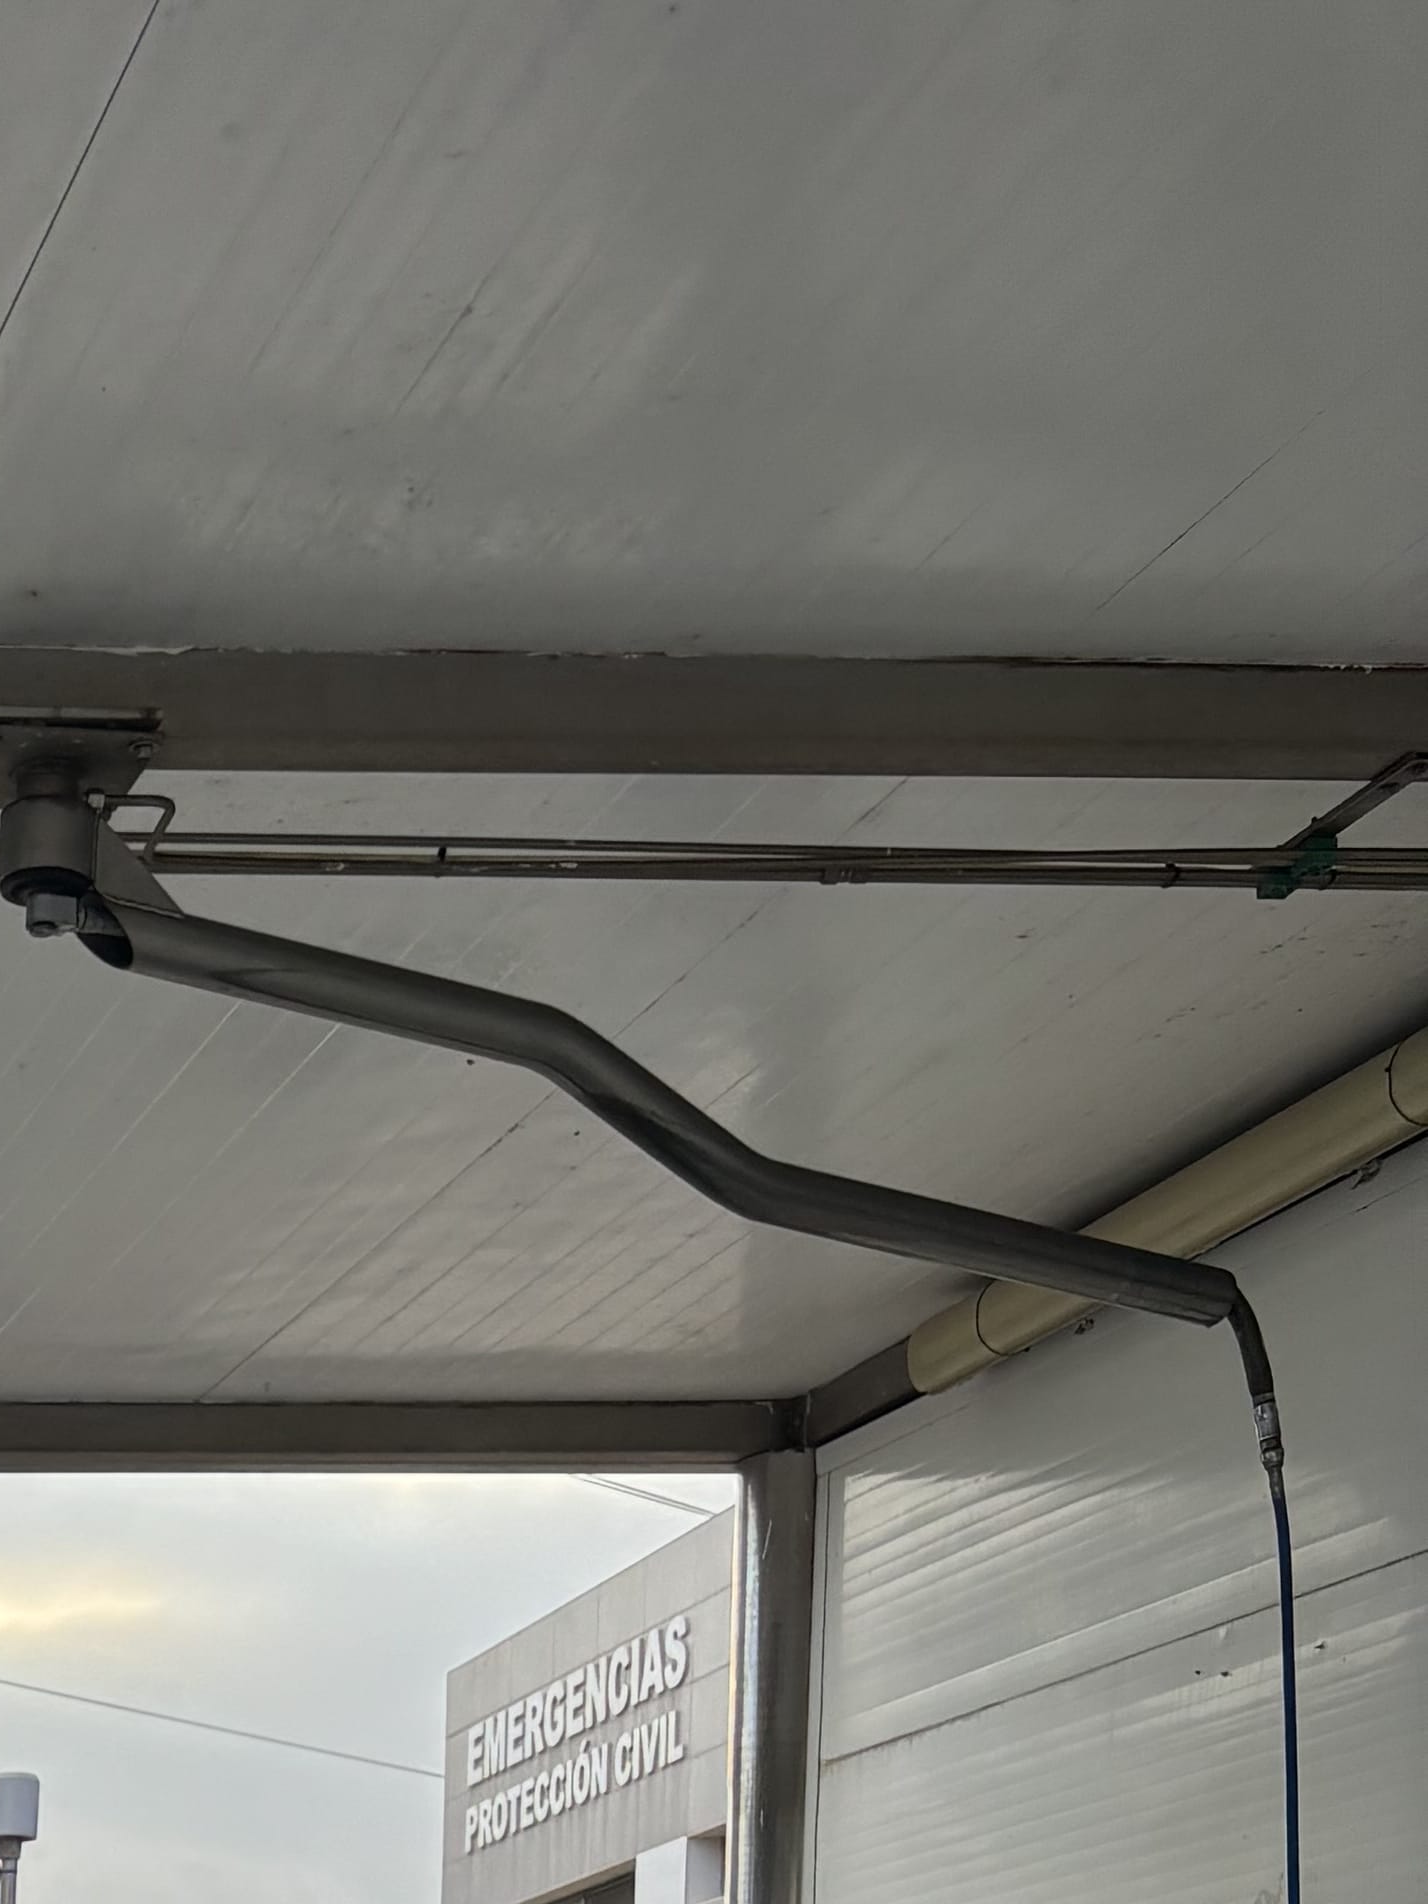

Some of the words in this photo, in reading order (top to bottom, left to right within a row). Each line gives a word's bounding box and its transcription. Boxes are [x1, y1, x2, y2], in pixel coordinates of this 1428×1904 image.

[466, 1614, 691, 1788] EMERGENCIAS
[463, 1739, 609, 1855] PROTECCIÓN
[614, 1710, 685, 1788] CIVIL
